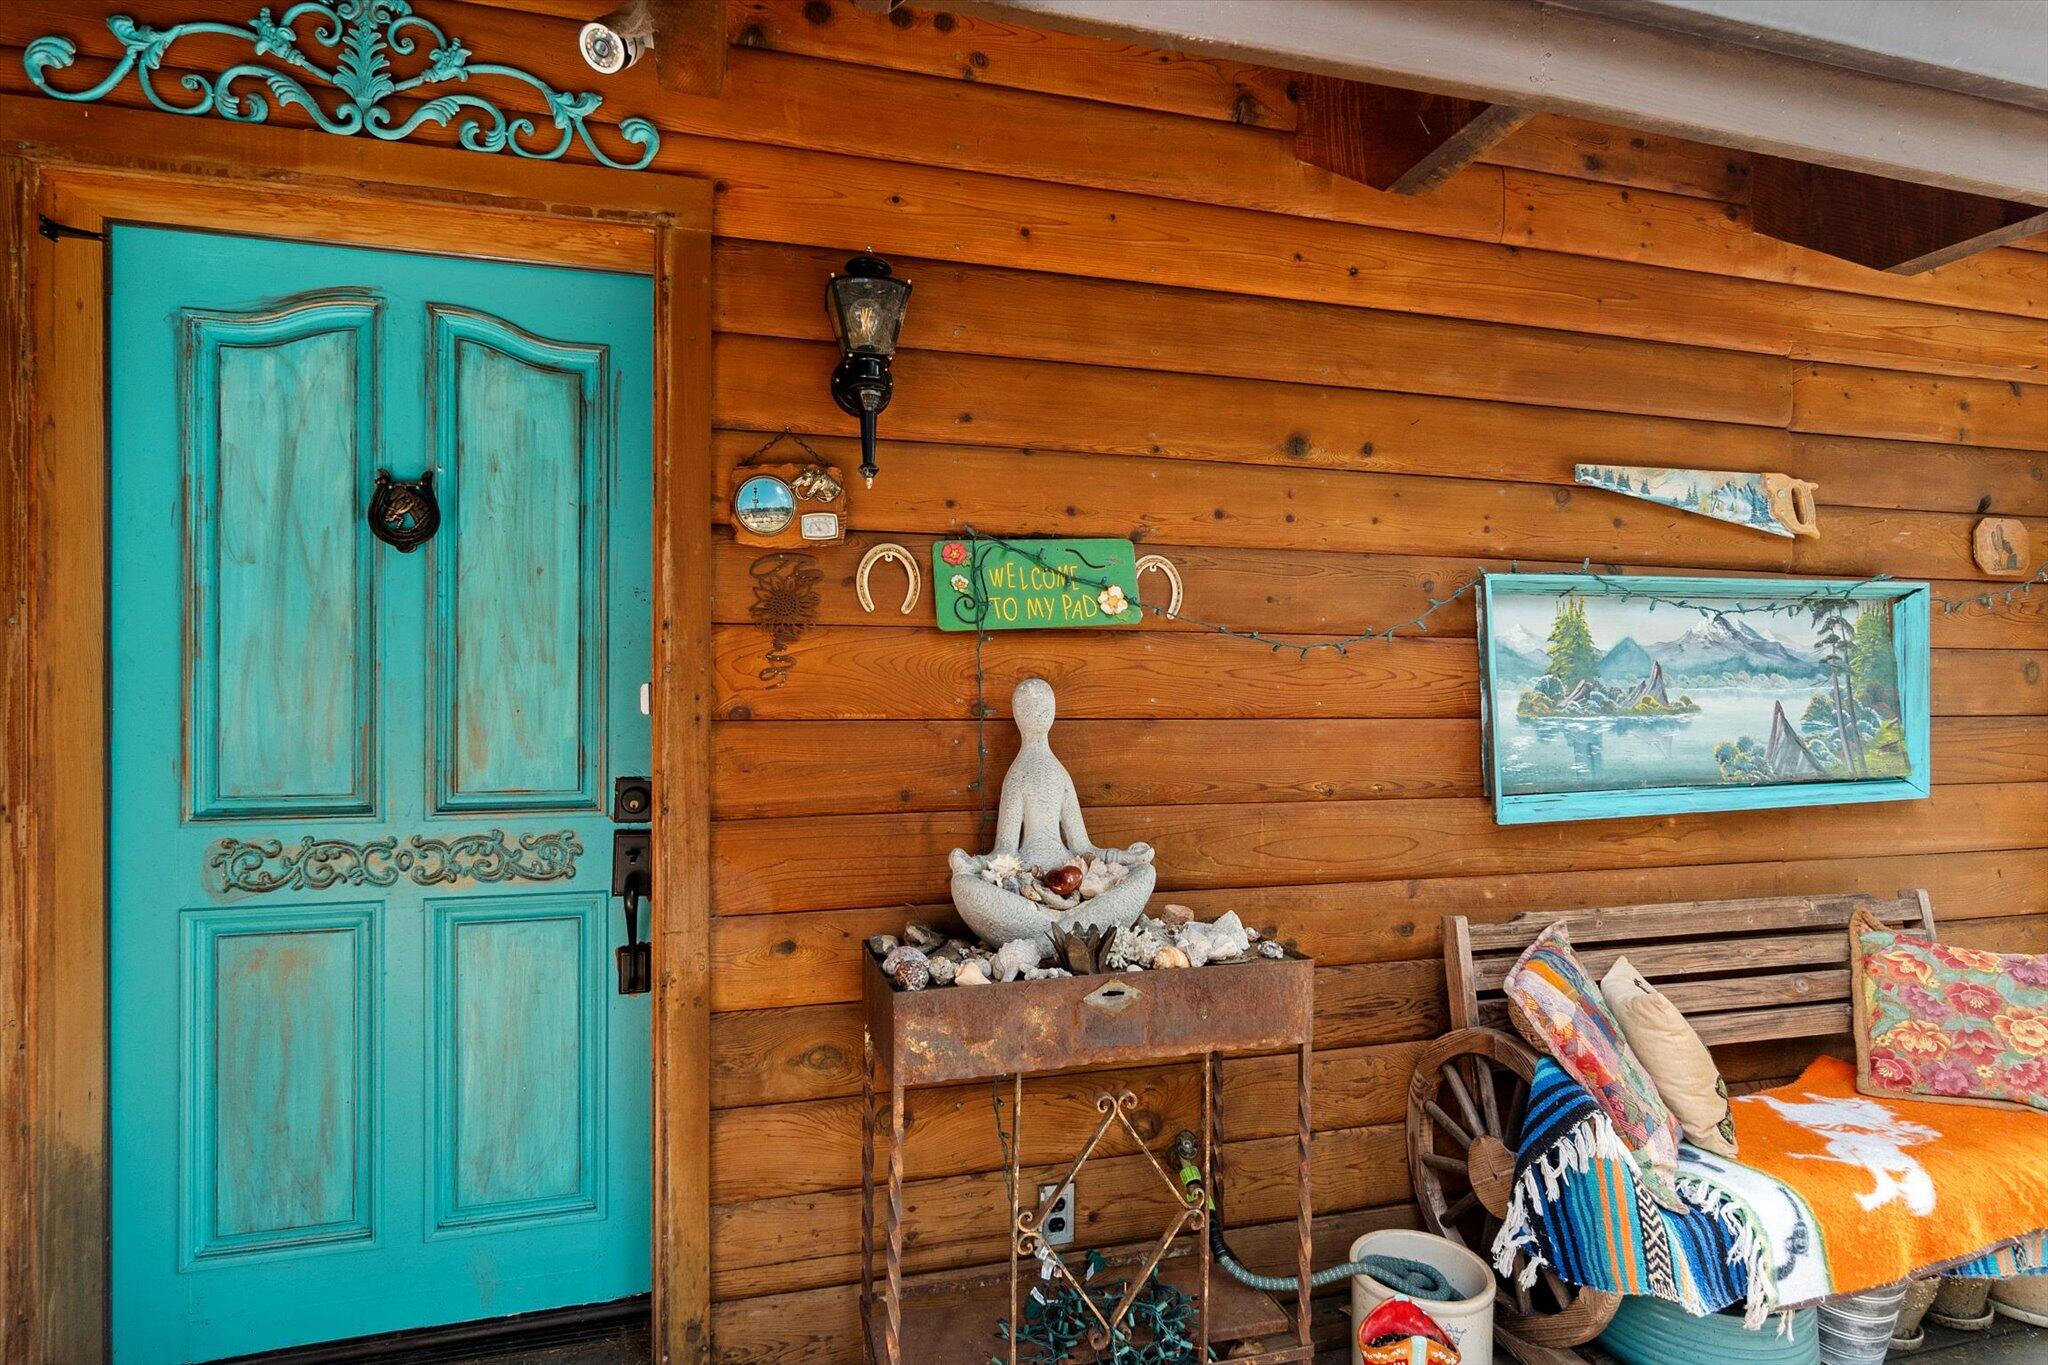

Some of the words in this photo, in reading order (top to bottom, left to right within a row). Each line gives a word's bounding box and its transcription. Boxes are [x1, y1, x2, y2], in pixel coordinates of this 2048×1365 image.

[989, 562, 1080, 591] WELCOME
[988, 597, 1018, 621] TO
[1026, 594, 1055, 621] MY
[1061, 593, 1098, 620] PAD
